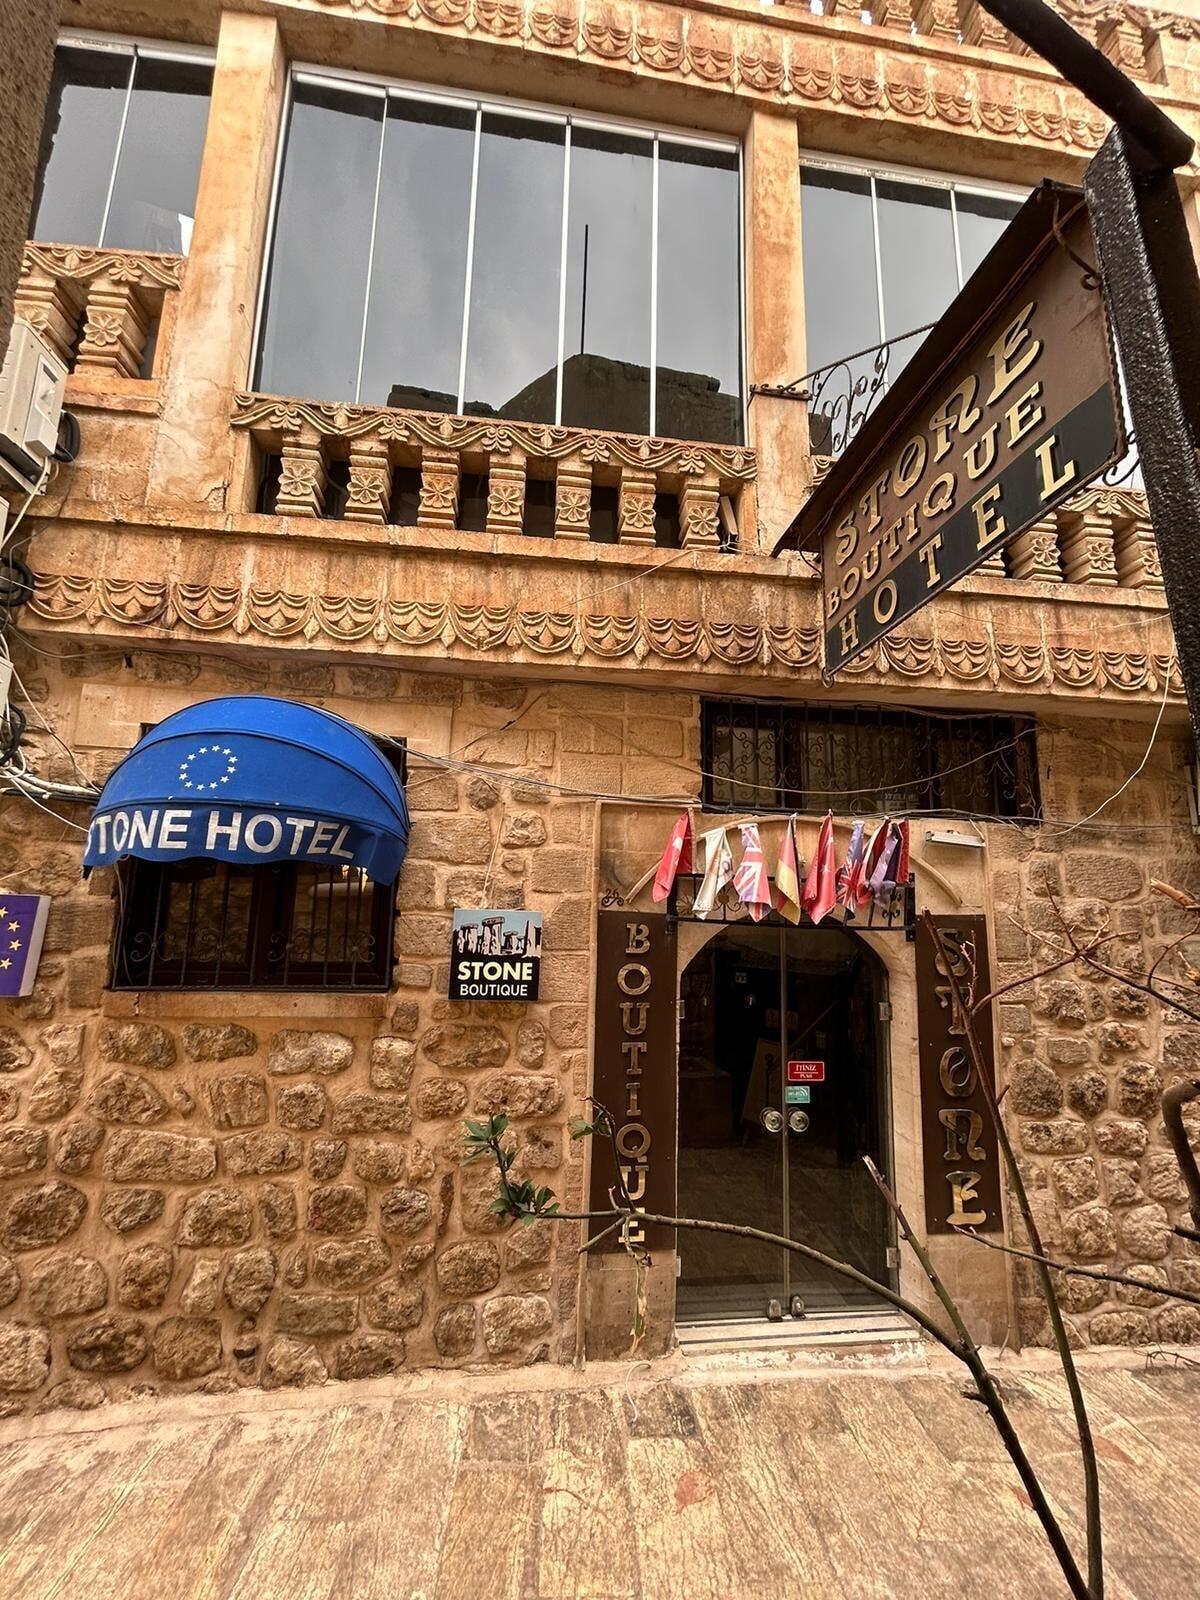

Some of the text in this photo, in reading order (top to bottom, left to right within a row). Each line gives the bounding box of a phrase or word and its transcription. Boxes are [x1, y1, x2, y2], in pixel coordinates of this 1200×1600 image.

[826, 381, 1044, 618] BOUTIQUE
[835, 301, 1041, 566] STONE
[839, 434, 1076, 656] HOTEL
[205, 810, 355, 860] HOTEL
[457, 961, 533, 981] STONE
[460, 984, 528, 997] BOUTIQUE
[934, 927, 987, 1225] STONE
